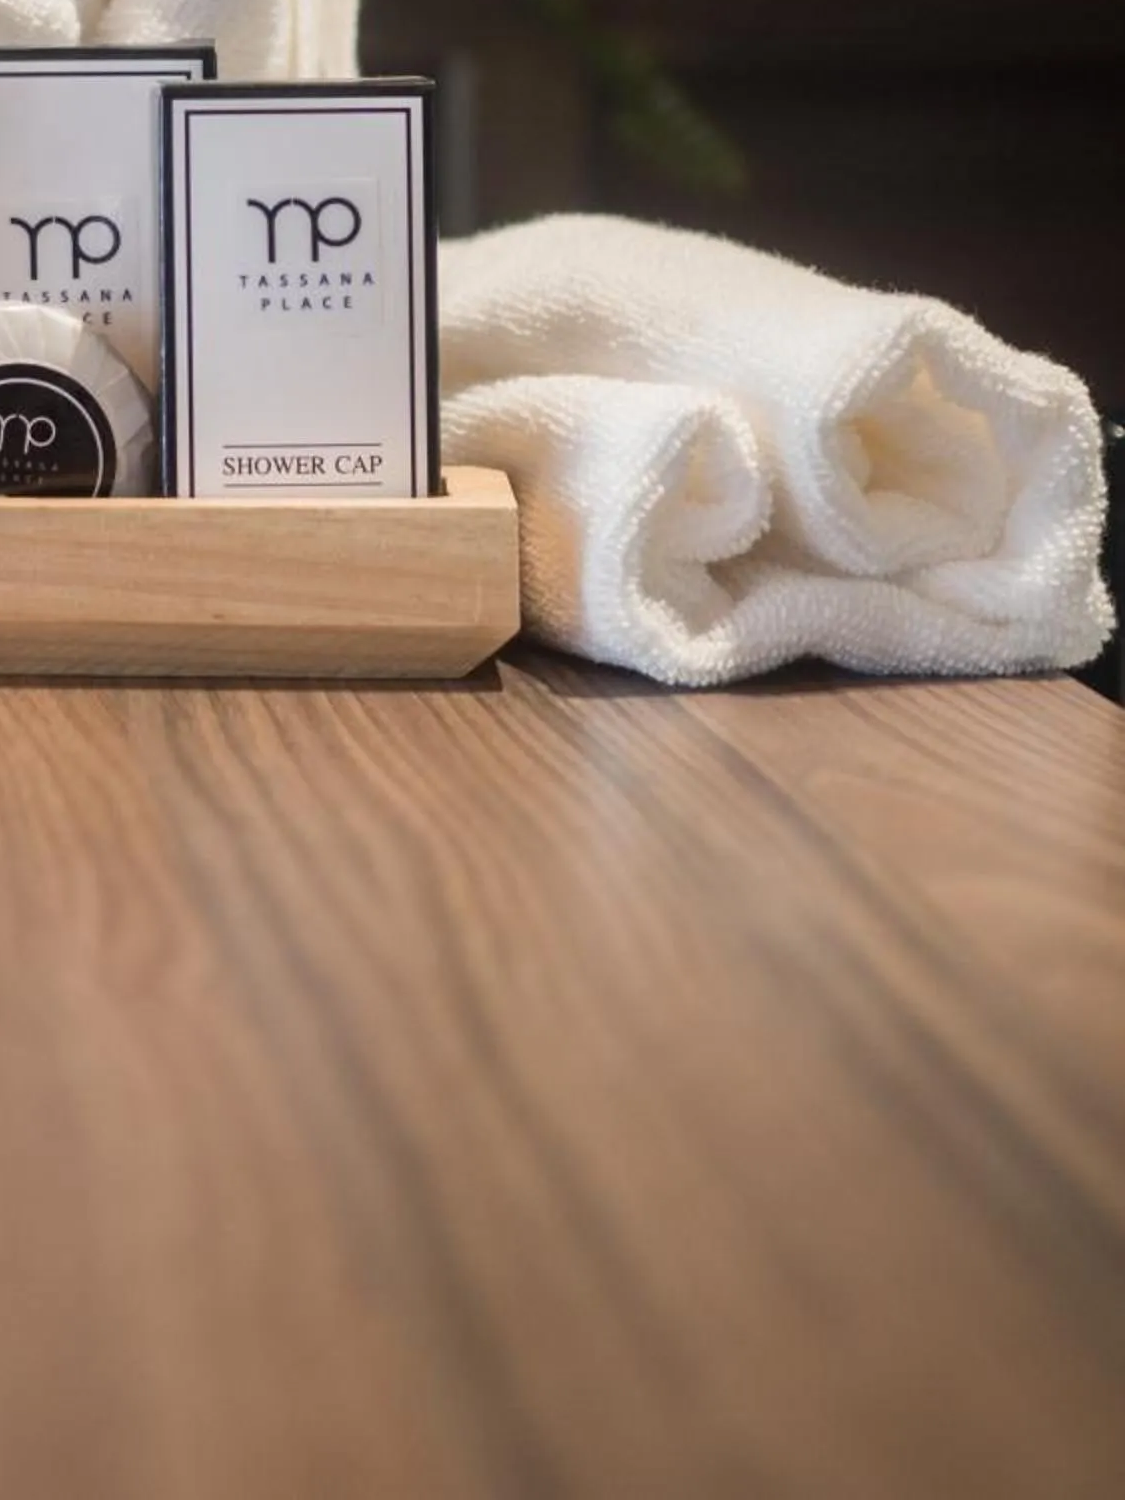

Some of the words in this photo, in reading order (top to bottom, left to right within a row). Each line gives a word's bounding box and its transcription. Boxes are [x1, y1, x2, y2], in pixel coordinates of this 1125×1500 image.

[239, 272, 375, 289] TASSANA
[3, 288, 132, 303] TASSANA
[260, 296, 353, 311] PLACE
[222, 456, 326, 476] SHOWER
[334, 455, 383, 475] CAP
